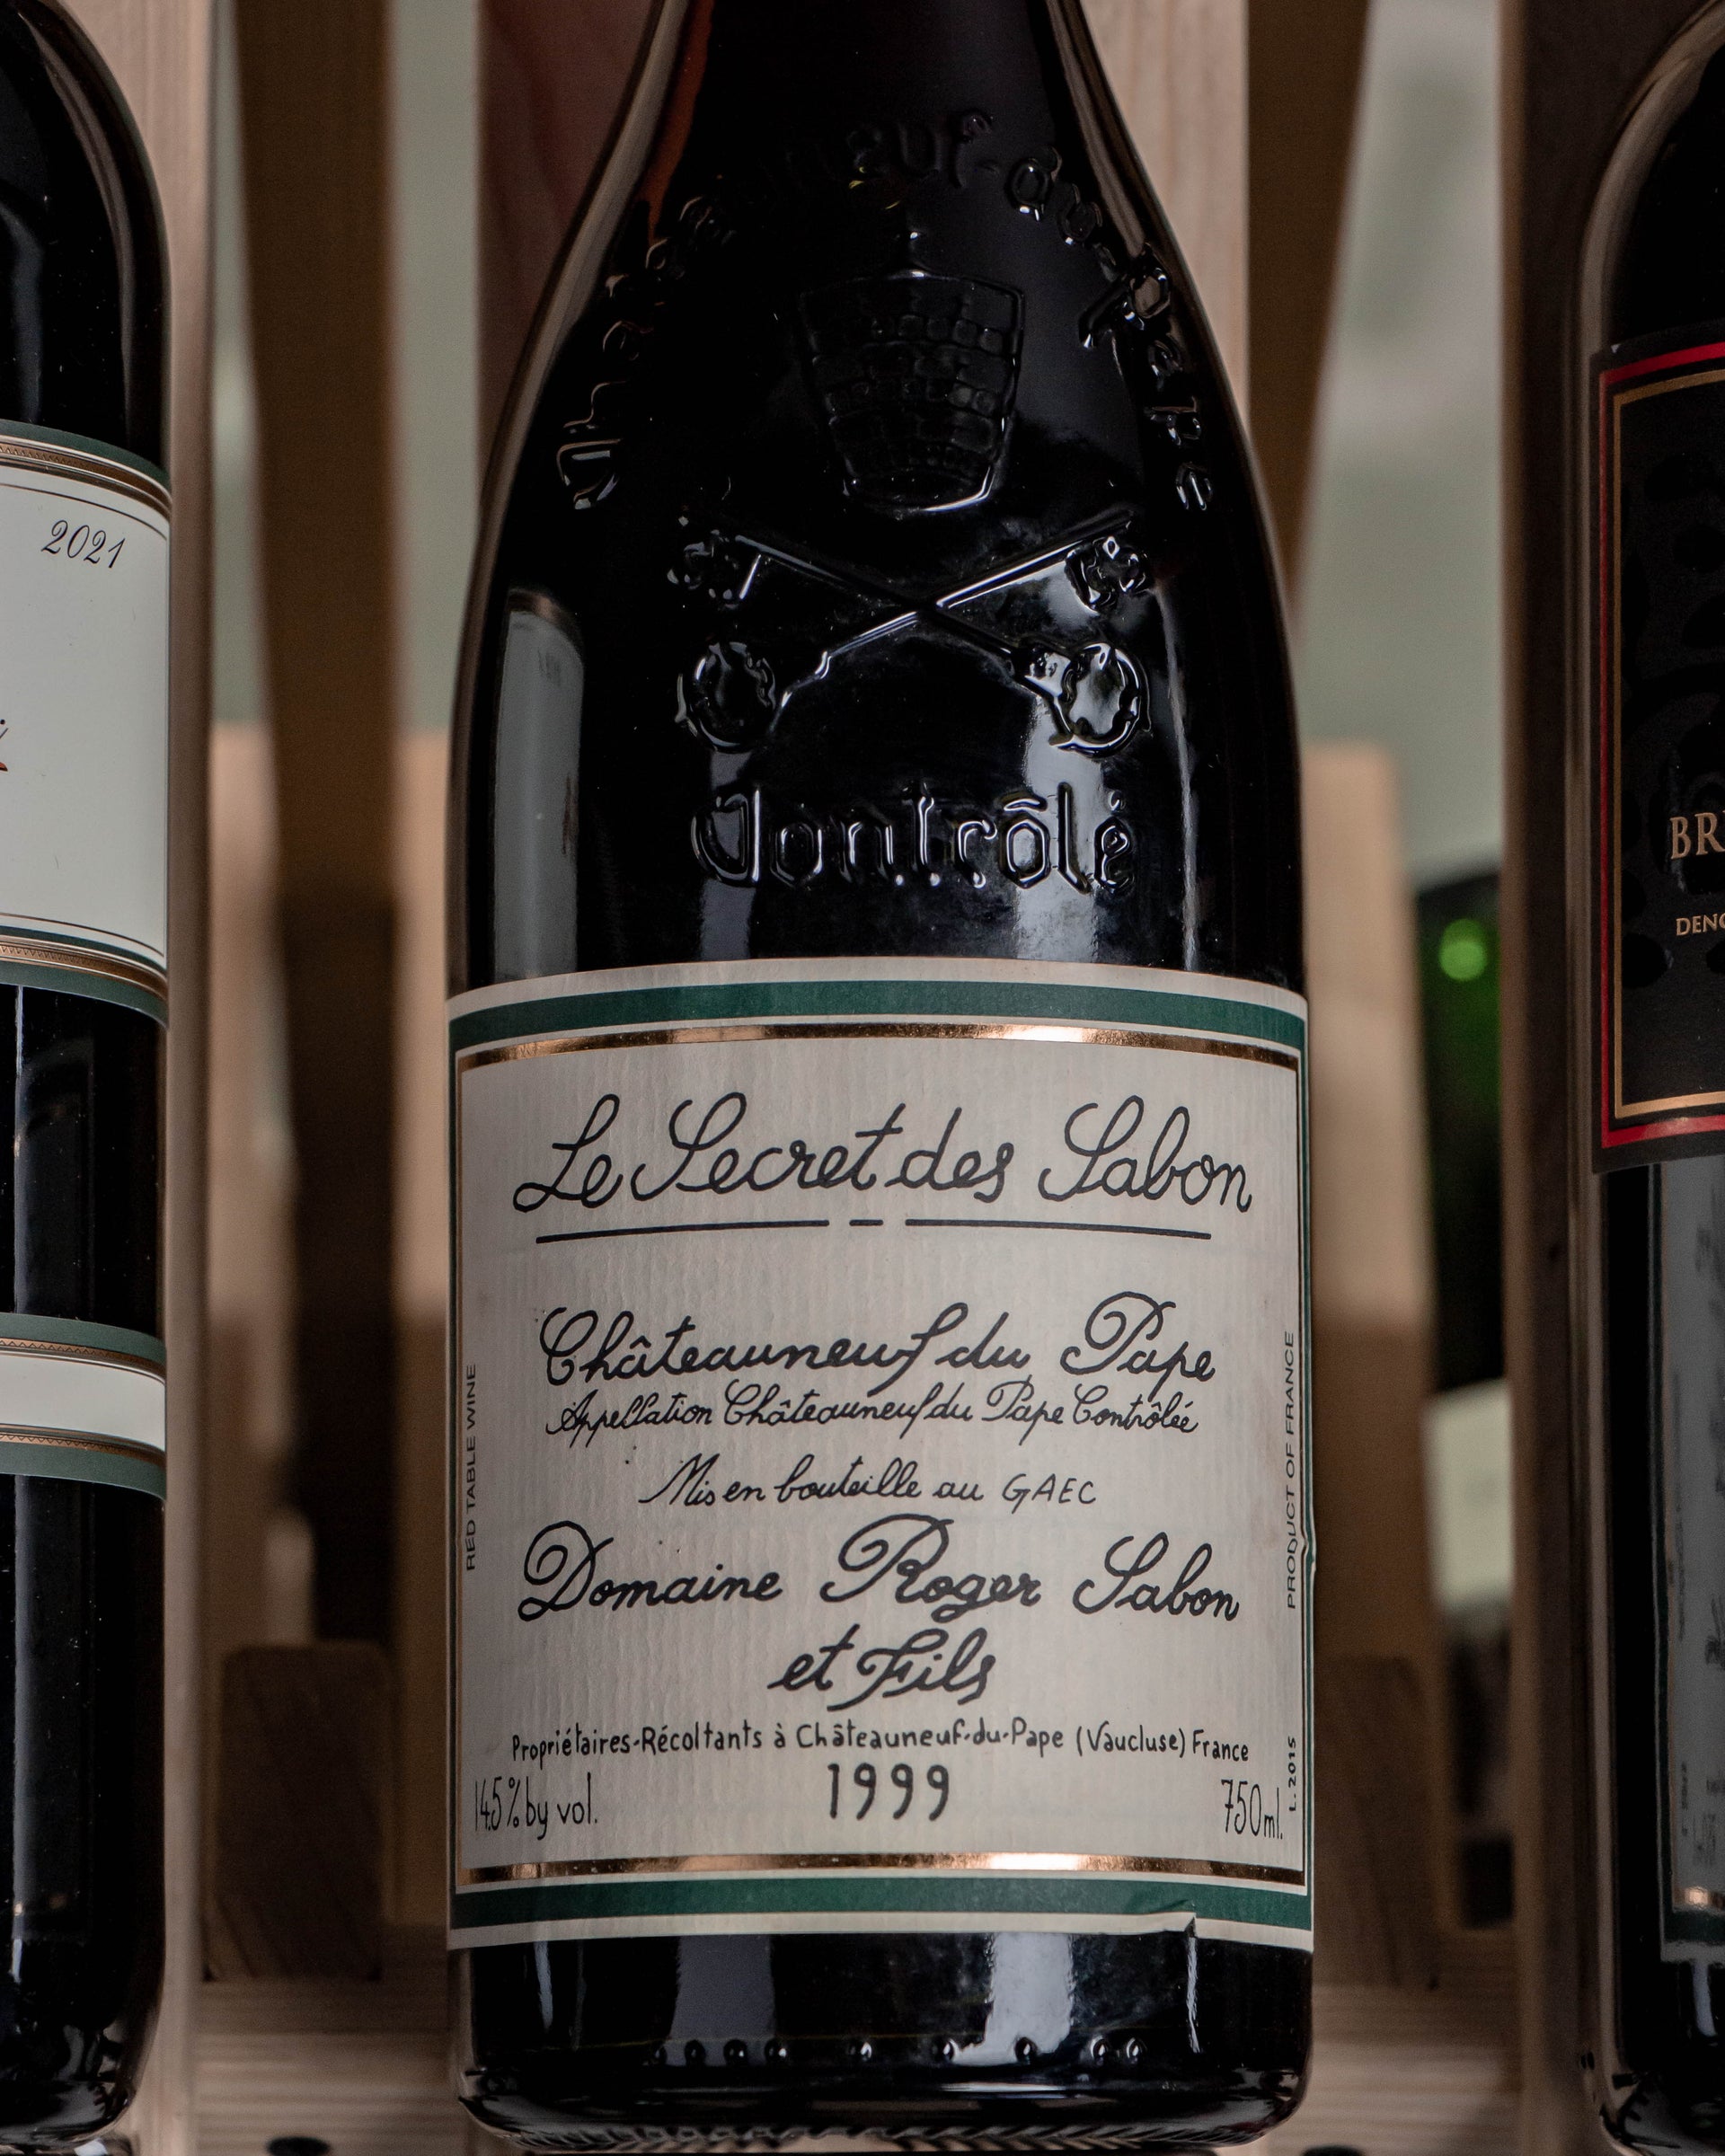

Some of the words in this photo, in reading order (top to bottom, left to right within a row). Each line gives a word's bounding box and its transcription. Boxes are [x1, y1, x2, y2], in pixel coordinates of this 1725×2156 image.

[40, 519, 127, 569] 2021
[1668, 809, 1725, 861] BR
[513, 1093, 624, 1212] Le
[631, 1091, 906, 1201] Secret
[884, 1107, 1014, 1204] des
[1038, 1095, 1252, 1213] Sabon
[539, 1302, 969, 1398] Châteauneuf
[934, 1312, 1031, 1369] du
[1060, 1291, 1216, 1402] Pape
[466, 1363, 476, 1430] WINE
[545, 1389, 712, 1448] Appellation
[723, 1378, 944, 1439] Châteauneuf
[924, 1382, 973, 1421] du
[981, 1374, 1065, 1445] Pape
[1284, 1330, 1296, 1436] FRANCE
[466, 1436, 476, 1515] TABLE
[638, 1453, 721, 1507] Mis
[721, 1480, 766, 1502] en
[773, 1454, 922, 1503] bouteille
[932, 1479, 985, 1502] au
[1002, 1472, 1097, 1514] GAEC
[1286, 1442, 1296, 1479] OF
[466, 1519, 476, 1571] RED
[518, 1520, 783, 1622] Domaine
[818, 1512, 1042, 1623] Roger
[1072, 1531, 1241, 1621] Sabon
[1286, 1484, 1299, 1610] PRODUCT
[766, 1623, 861, 1692] et
[826, 1627, 997, 1711] Fils
[512, 1719, 763, 1771] Propriétaires-Récoltants
[774, 1722, 787, 1749] à
[796, 1716, 1064, 1758] Châteauneuf-du-Pape
[1076, 1720, 1187, 1759] (Vaucluse)
[1192, 1728, 1250, 1763] France
[1287, 1735, 1296, 1789] 2015
[525, 1775, 549, 1842] by
[556, 1772, 598, 1825] vol.
[827, 1762, 951, 1821] 1999
